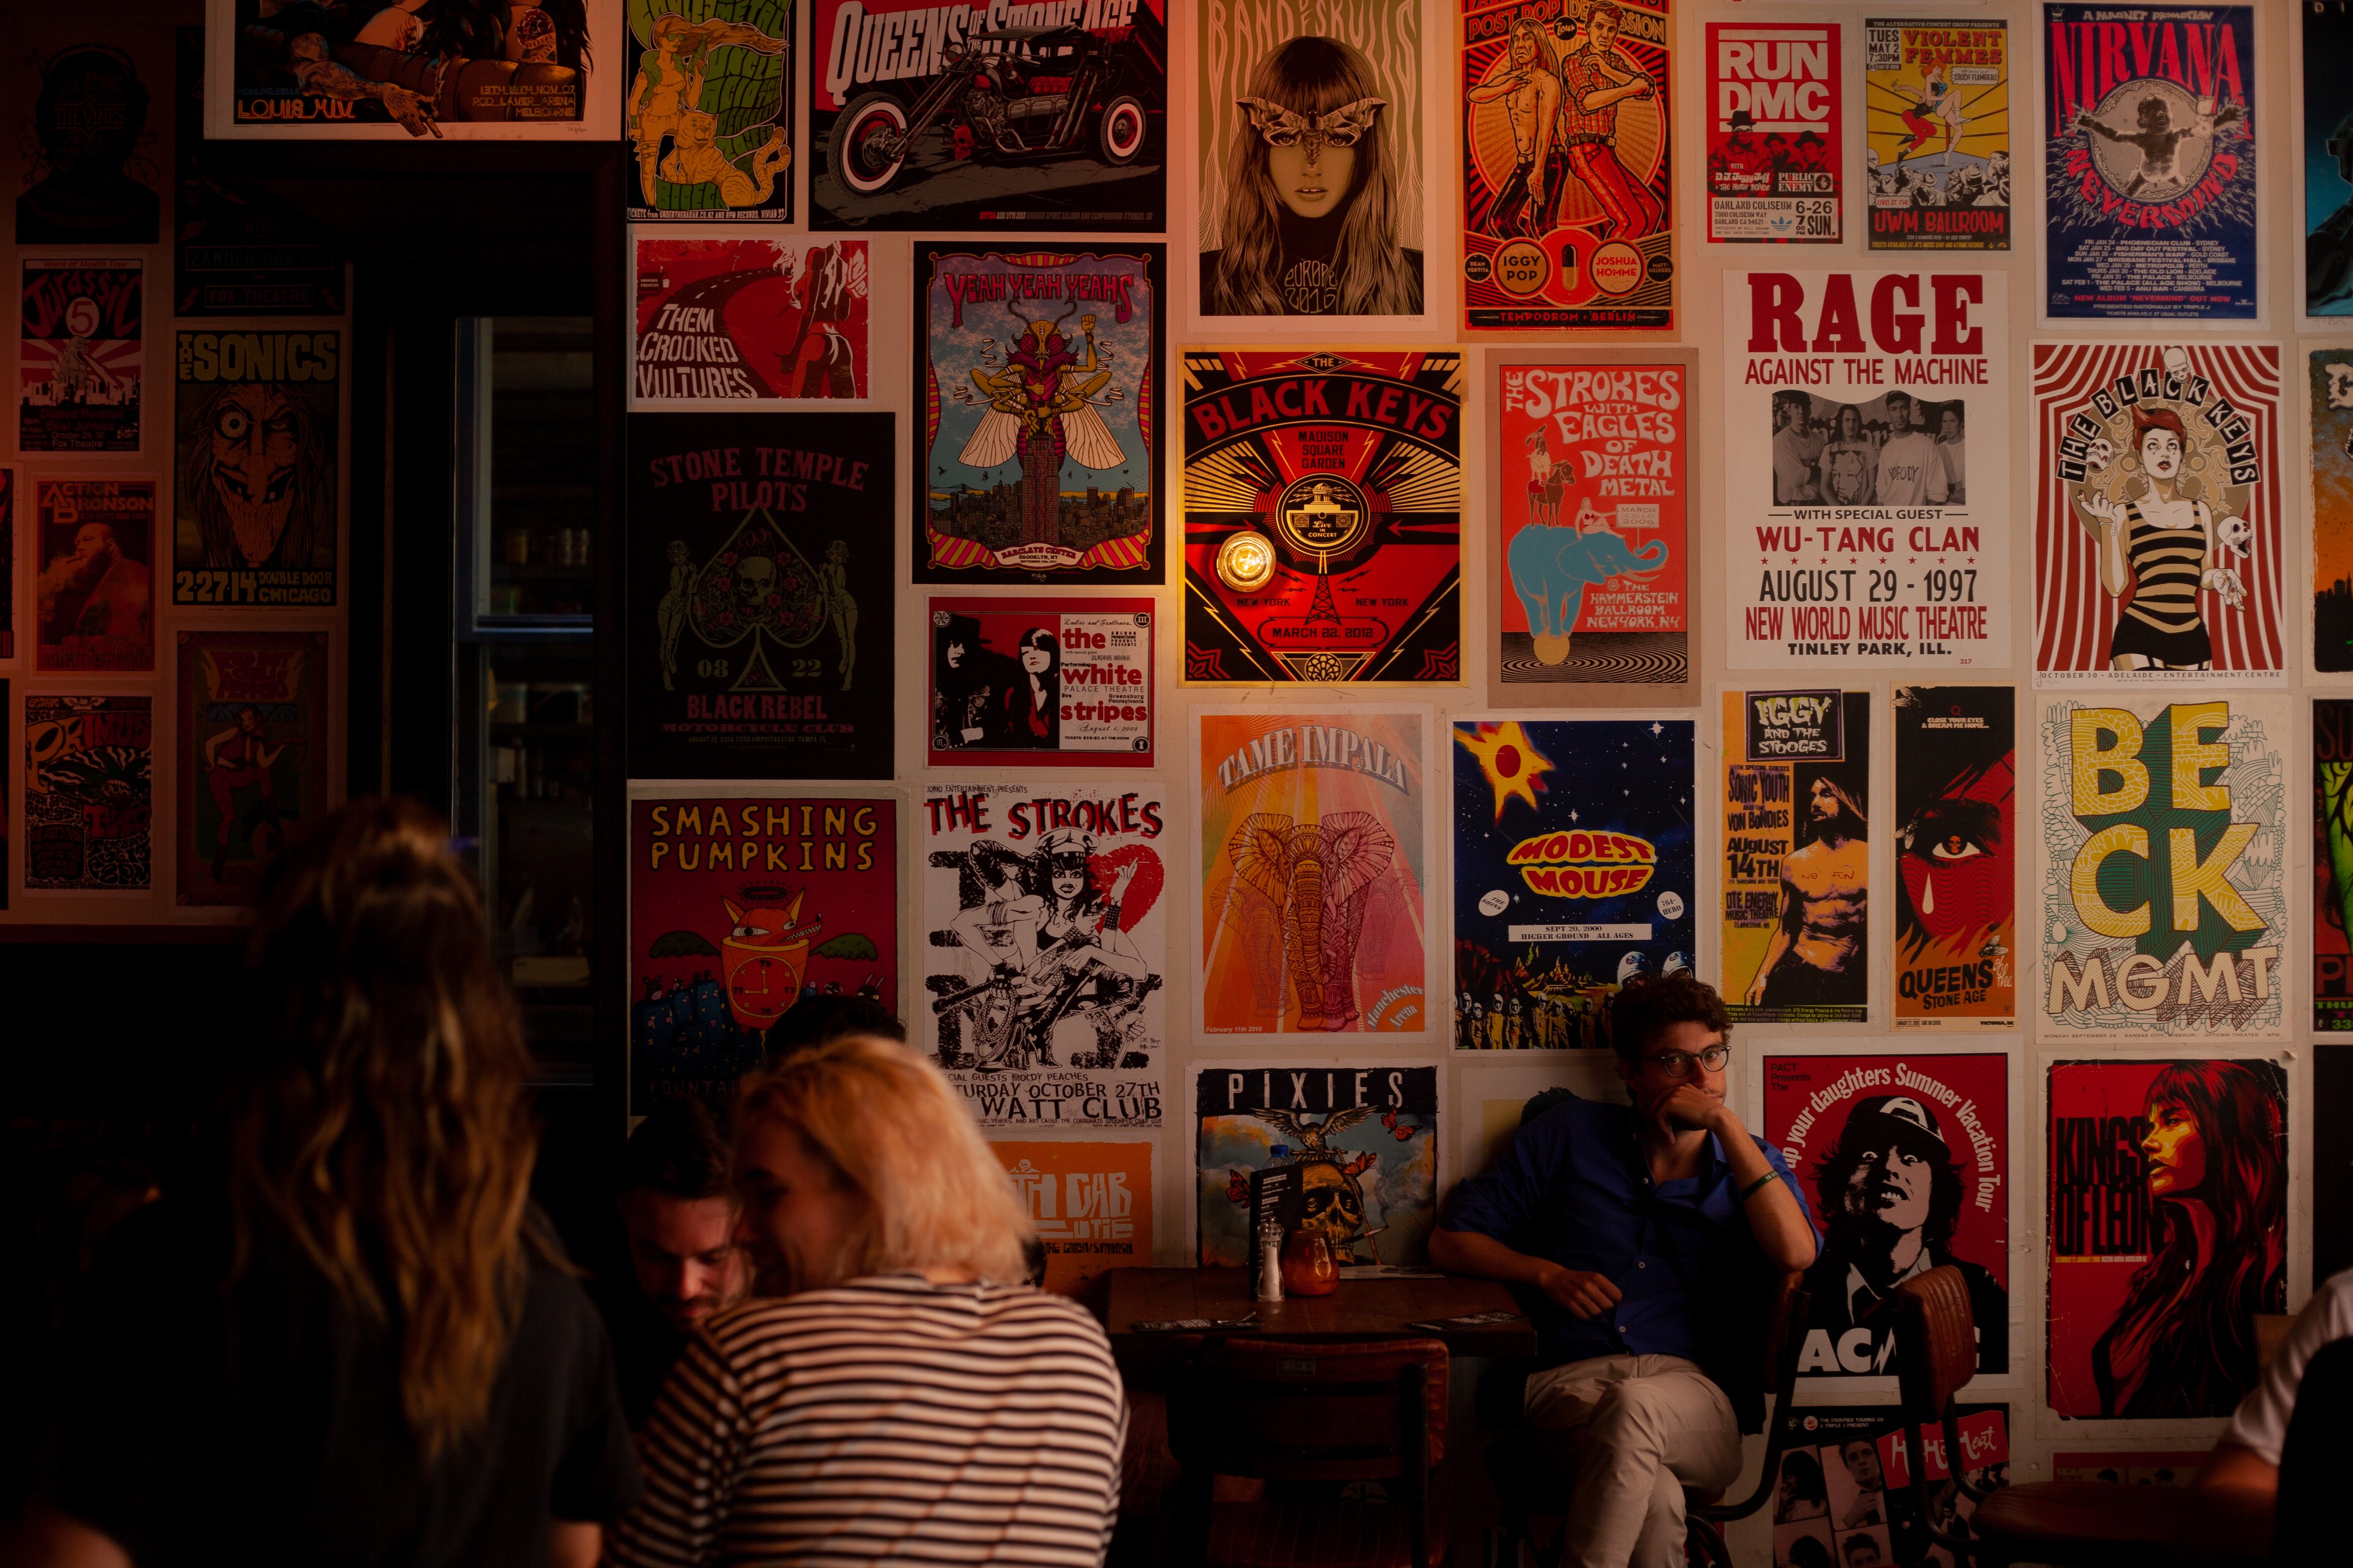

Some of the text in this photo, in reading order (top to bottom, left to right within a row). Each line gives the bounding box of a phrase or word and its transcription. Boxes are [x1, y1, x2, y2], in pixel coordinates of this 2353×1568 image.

[1869, 44, 1899, 52] MAY 2
[1870, 31, 1899, 42] TUES
[1903, 31, 2002, 47] VIOLENT
[825, 0, 970, 105] QUEENS
[1719, 42, 1828, 80] RUN
[1869, 53, 1900, 62] 7:30PM
[1905, 48, 2002, 64] FEMMES
[2051, 23, 2253, 140] NIRVANA
[238, 99, 356, 118] LOUIS XIV
[1719, 82, 1829, 120] DMC
[2067, 150, 2238, 227] NEVERMIND
[1715, 202, 1792, 210] OAKLAND COLISEUM
[1796, 202, 1832, 214] 6-26
[1808, 215, 1835, 235] SUN.
[1875, 211, 2003, 232] UWM BALLROOM
[1504, 256, 1540, 267] IGGY
[1596, 257, 1638, 265] JOSHUA
[1596, 268, 1637, 276] HOMME
[1507, 271, 1537, 281] POP
[944, 273, 1134, 329] YEAH YEAH YEAHS
[657, 303, 714, 332] THEM
[1500, 312, 1636, 321] TEMPODROM BERLIN
[1748, 274, 1982, 354] RAGE
[194, 333, 336, 381] SONICS
[640, 332, 738, 362] CROOKED
[640, 364, 758, 398] VULTURES
[1745, 359, 1988, 384] AGAINST THE MACHINE
[1506, 370, 1524, 412] THE
[1526, 370, 1680, 418] STROKES
[1192, 380, 1454, 440] BLACK KEYS
[1298, 431, 1348, 442] MADISON
[1553, 412, 1675, 444] EAGLES
[2091, 368, 2261, 486] BLACK KEYS
[1303, 445, 1345, 457] SQUARE
[1606, 440, 1637, 452] OF
[649, 447, 869, 491] STONE TEMPLE
[1302, 458, 1345, 469] GARDEN
[1581, 451, 1672, 478] DEATH
[711, 481, 808, 511] PILOTS
[1598, 479, 1674, 496] METAL
[1794, 510, 1942, 519] WITH SPECIAL GUEST
[1756, 527, 1979, 552] WU-TANG CLAN
[259, 588, 332, 603] CHICAGO
[1760, 569, 1977, 601] AUGUST 29 1997
[1591, 593, 1678, 604] HAMMERSTEIN
[1595, 606, 1665, 615] BALLROOM
[1273, 628, 1373, 640] MARCH 22, 2012
[1746, 607, 1987, 640] NEW WORLD MUSIC THEATRE
[1062, 628, 1106, 649] the
[1789, 643, 1951, 657] TINLEY PARK, ILL.
[697, 658, 822, 678] 08 22
[1062, 663, 1141, 685] white
[688, 694, 827, 720] BLACK REBEL
[1061, 701, 1147, 722] stripes
[1755, 697, 1832, 726] IGGY
[661, 723, 854, 733] MOTORCYCLE CLUB
[1218, 725, 1408, 793] TAME IMPALA
[1759, 740, 1827, 753] STOOGES
[651, 806, 876, 836] SMASHING
[924, 792, 1163, 840] THE STROKES
[651, 841, 874, 871] PUMPKINS
[1511, 833, 1651, 861] MODEST
[1727, 853, 1778, 878] 14TH
[1525, 868, 1651, 895] MOUSE
[1899, 959, 1994, 1000] QUEENS
[2048, 946, 2278, 1014] MGMT
[1367, 985, 1424, 1031] Manchester
[1923, 990, 1985, 1010] STONE AGE
[1389, 1004, 1419, 1030] Arena
[1771, 1063, 1797, 1071] PACT
[1028, 1081, 1160, 1099] OCTOBER 27TH
[1228, 1072, 1402, 1109] PIXIES
[982, 1097, 1162, 1120] WATT CLUB
[1786, 1062, 2000, 1213] your daughters Summer Vacation Tour
